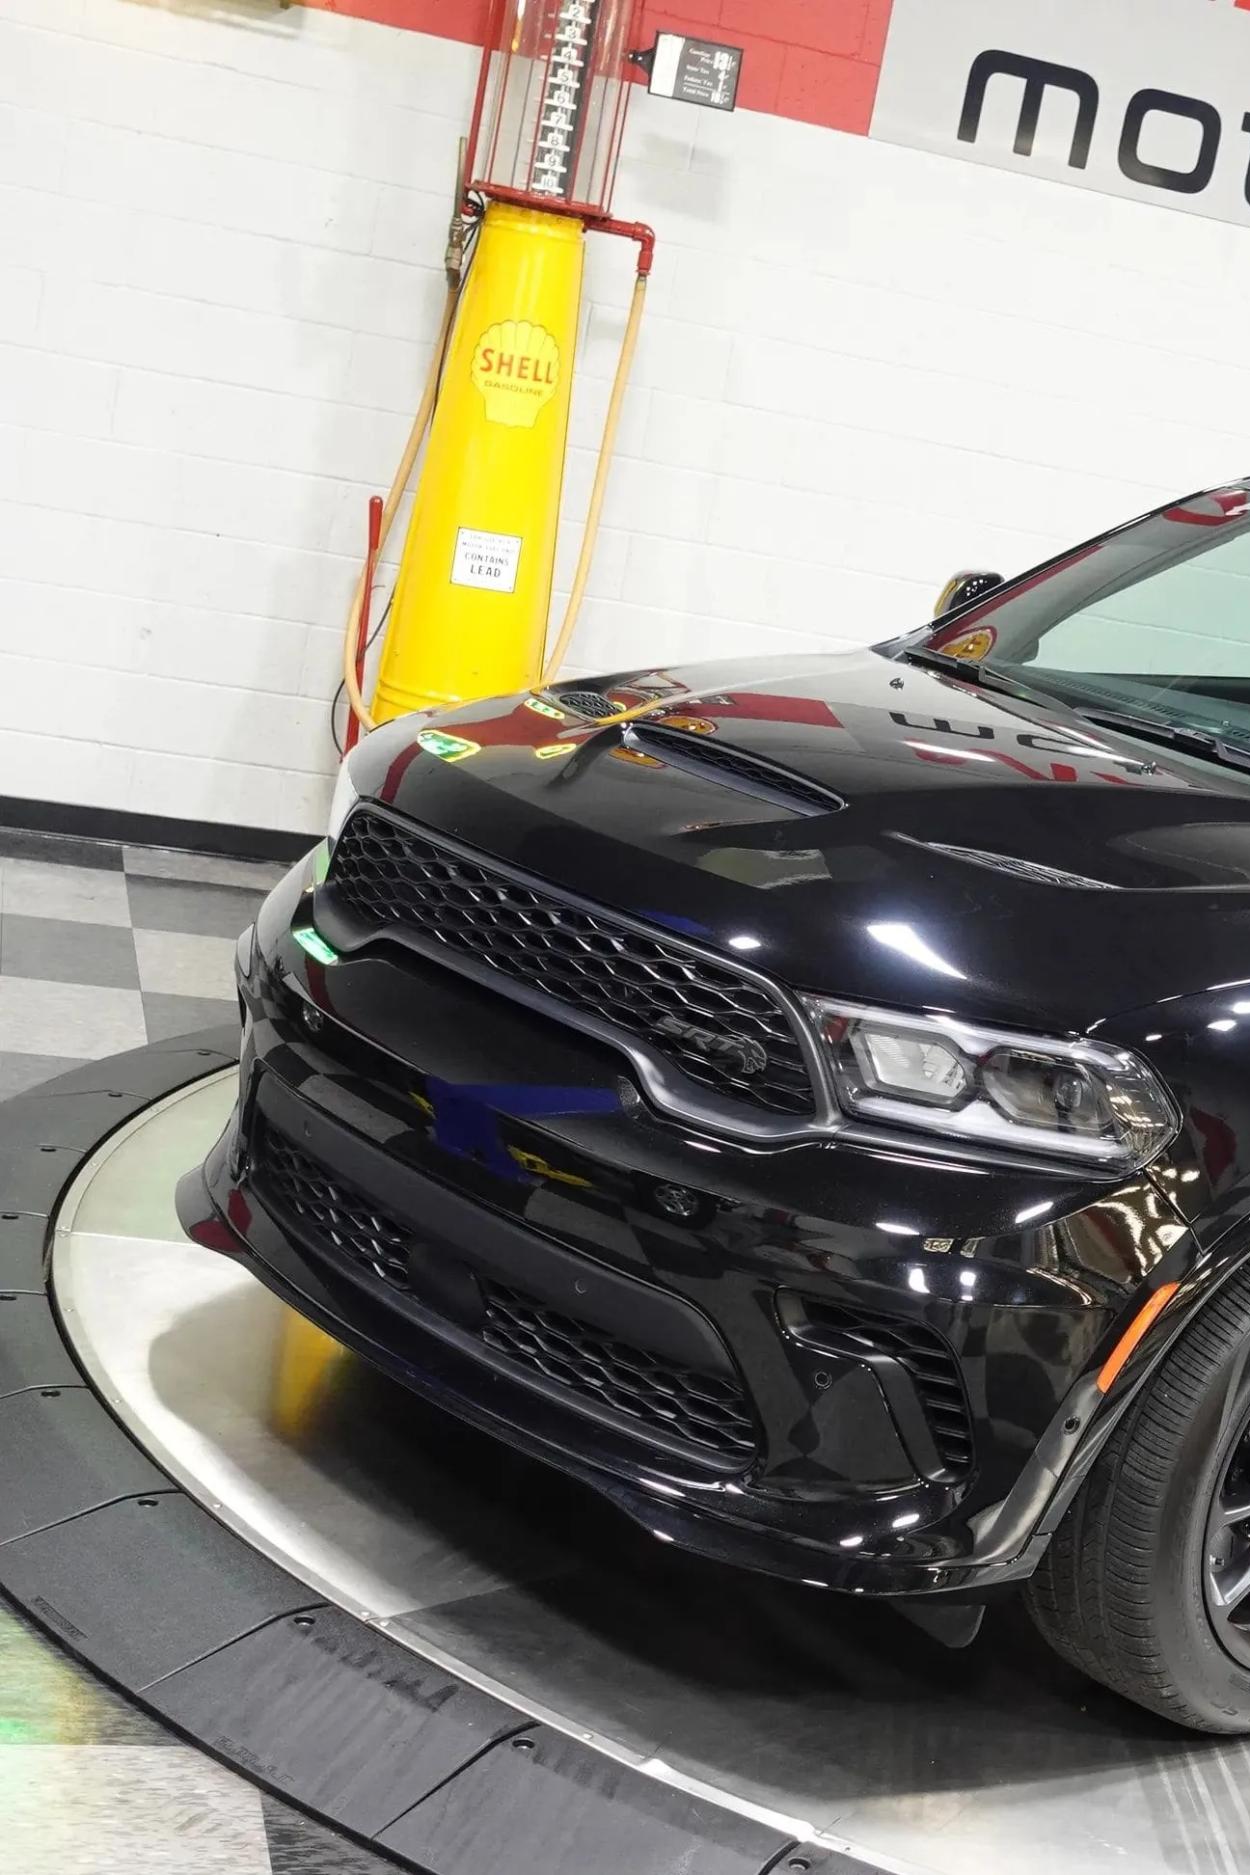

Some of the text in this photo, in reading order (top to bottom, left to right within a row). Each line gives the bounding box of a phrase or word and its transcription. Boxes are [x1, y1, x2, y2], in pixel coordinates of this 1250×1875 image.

[480, 348, 553, 384] SHELL
[465, 551, 509, 566] CONTAINS
[470, 564, 501, 577] LEAD
[656, 1017, 744, 1052] SRT
